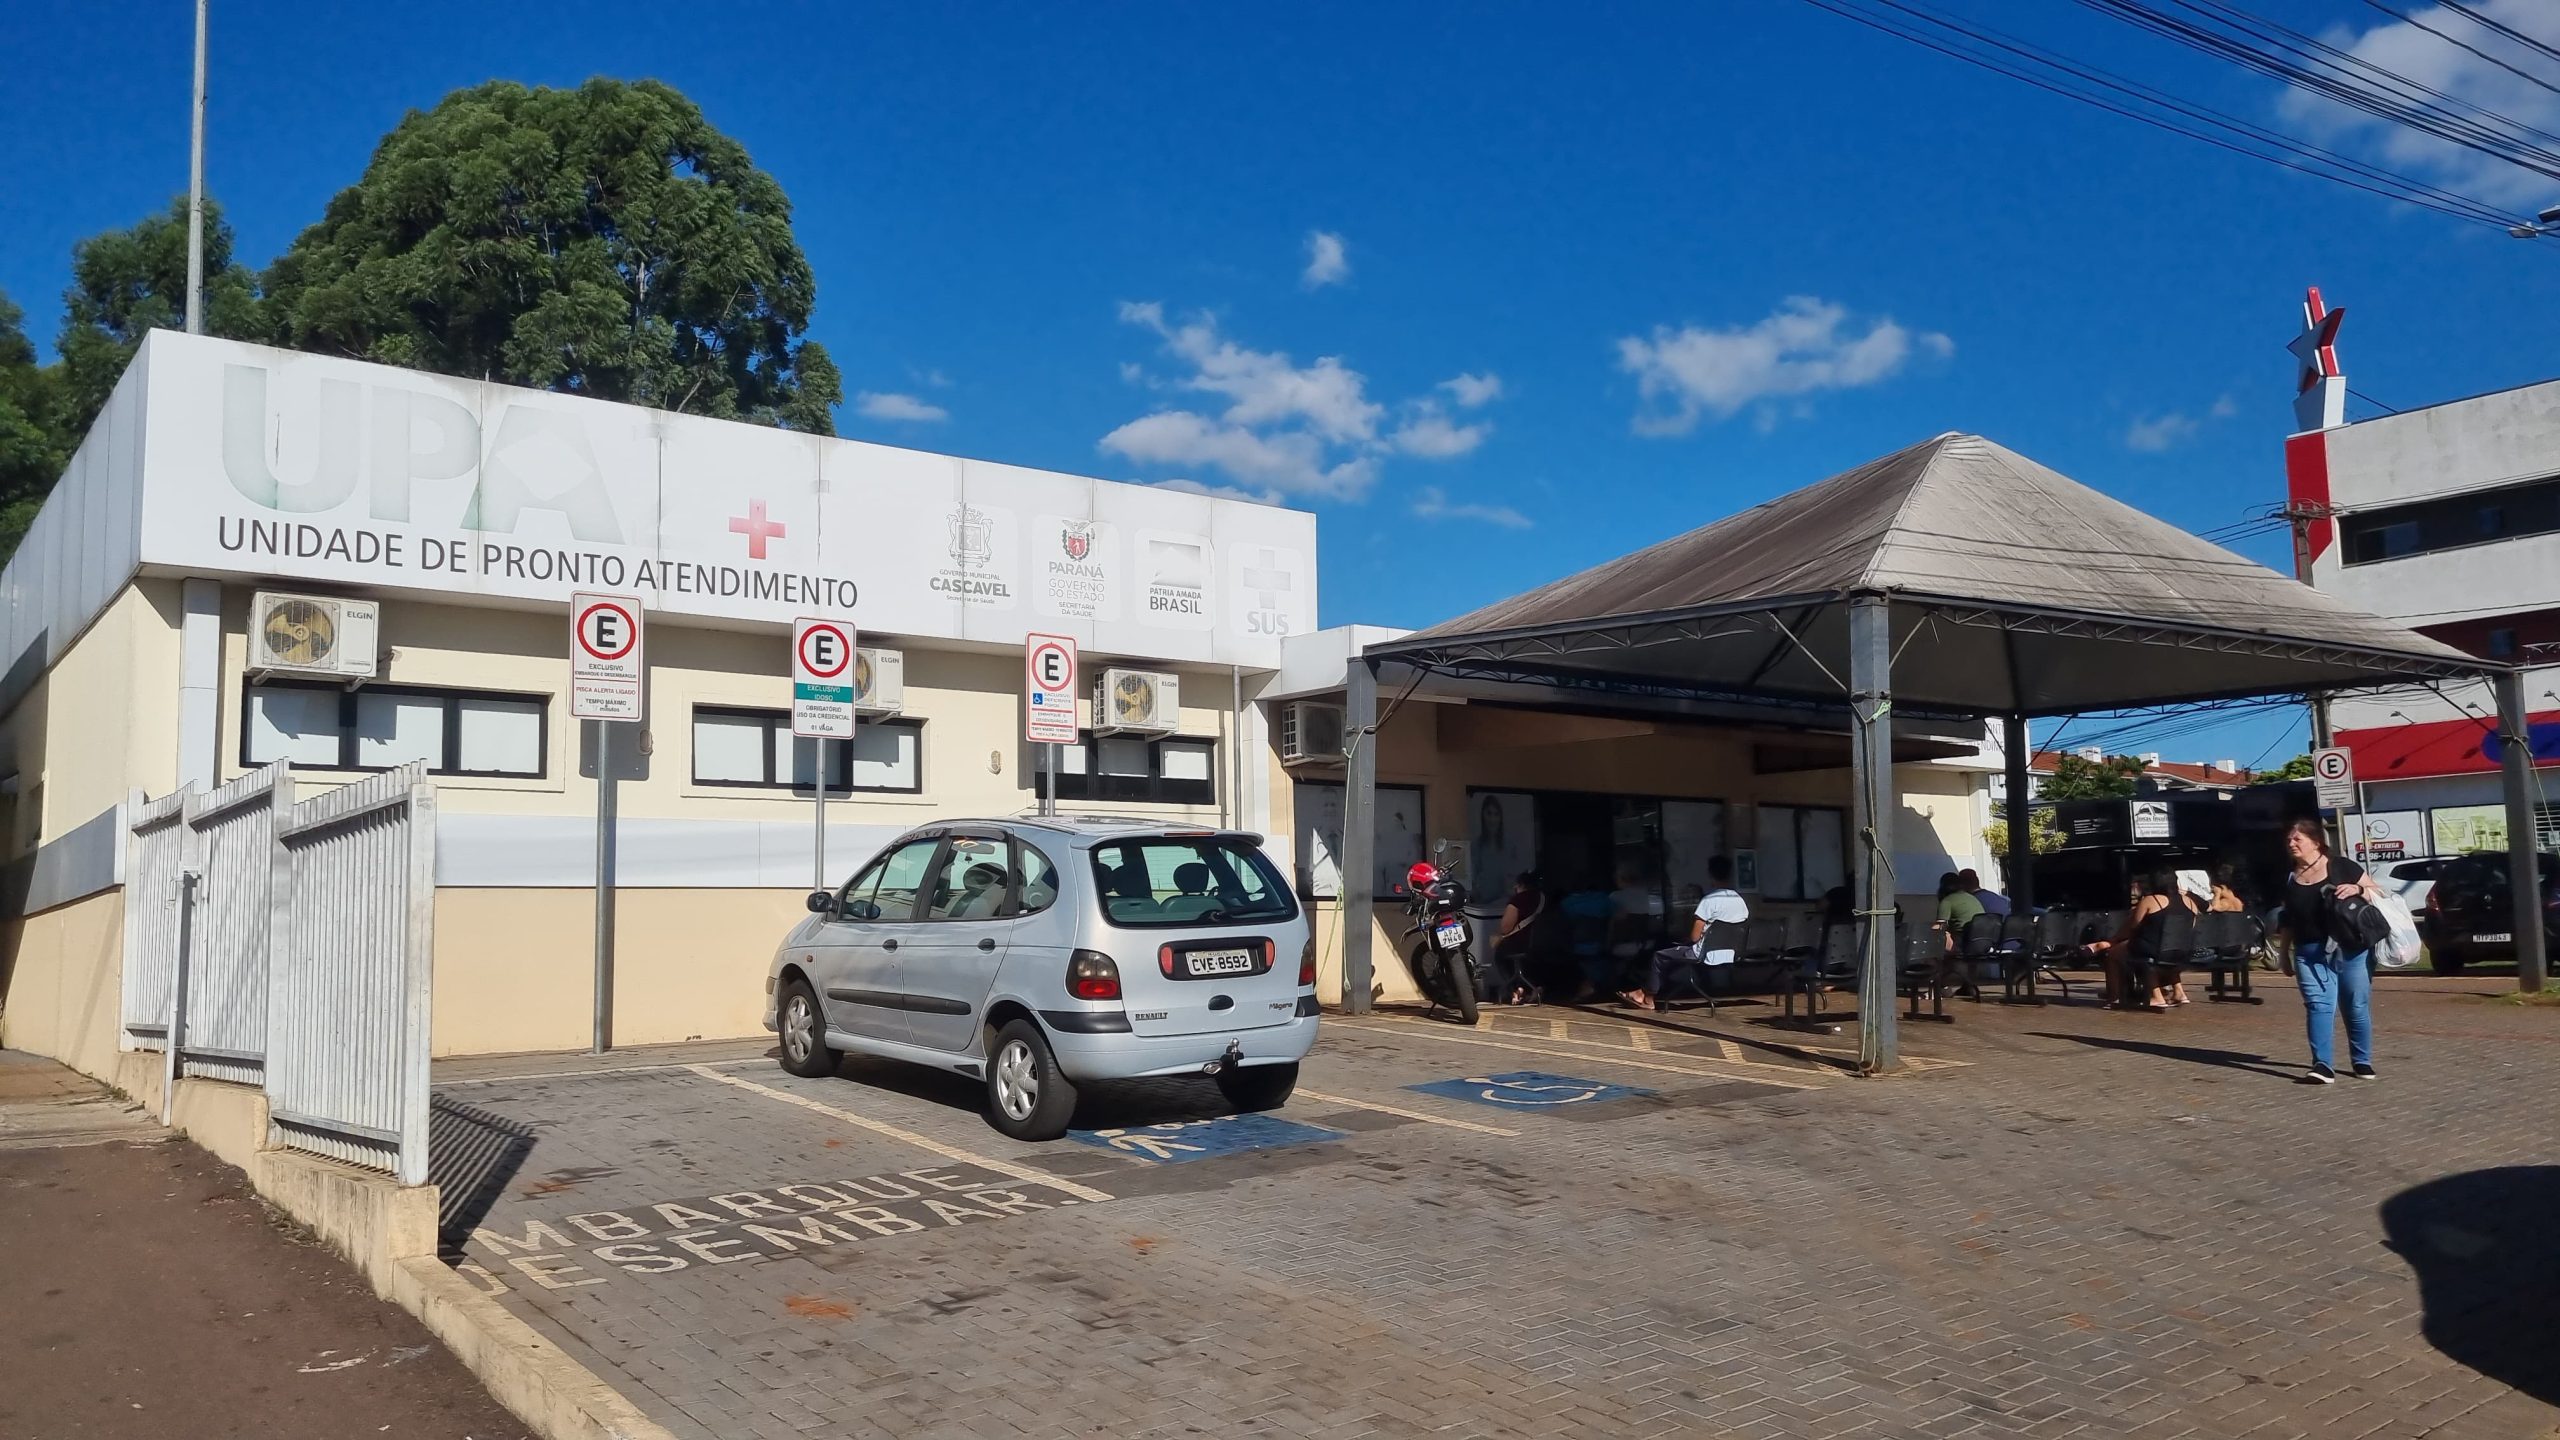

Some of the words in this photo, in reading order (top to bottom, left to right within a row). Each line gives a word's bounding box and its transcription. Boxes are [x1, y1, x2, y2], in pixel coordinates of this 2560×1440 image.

[222, 363, 626, 545] UPA
[218, 516, 404, 568] UNIDADE
[421, 538, 468, 574] DE
[483, 543, 625, 587] PRONTO
[634, 559, 858, 608] ATENDIMENTO
[939, 568, 967, 578] GOVERNO
[969, 571, 1001, 581] MUNICIPAL
[1048, 561, 1105, 579] PARANÁ
[929, 577, 1011, 598] CASCAVEL
[1048, 578, 1105, 593] GOVERNO
[1048, 588, 1064, 598] DO
[1066, 589, 1105, 602] ESTADO
[1176, 590, 1202, 600] AMADA
[1058, 601, 1096, 610] SECRETARIA
[1149, 595, 1203, 615] BRASIL
[346, 610, 373, 620] ELGIN
[1247, 610, 1290, 636] SUS
[596, 615, 617, 648] E
[815, 635, 834, 665] E
[880, 656, 900, 664] ELGIN
[588, 663, 624, 672] EXCLUSIVO
[1044, 653, 1060, 682] E
[807, 684, 841, 694] EXCLUSIVO
[1161, 680, 1178, 688] ELGIN
[615, 688, 636, 696] LIGADO
[814, 693, 834, 702] IDOSO
[805, 704, 842, 713] OBRIGATÓRIO
[817, 712, 851, 721] CREDENCIAL
[2327, 758, 2339, 774] E
[2359, 851, 2401, 861] 396-1414
[1134, 1012, 1168, 1021] RENAULT
[460, 1167, 985, 1256] MBARQUE
